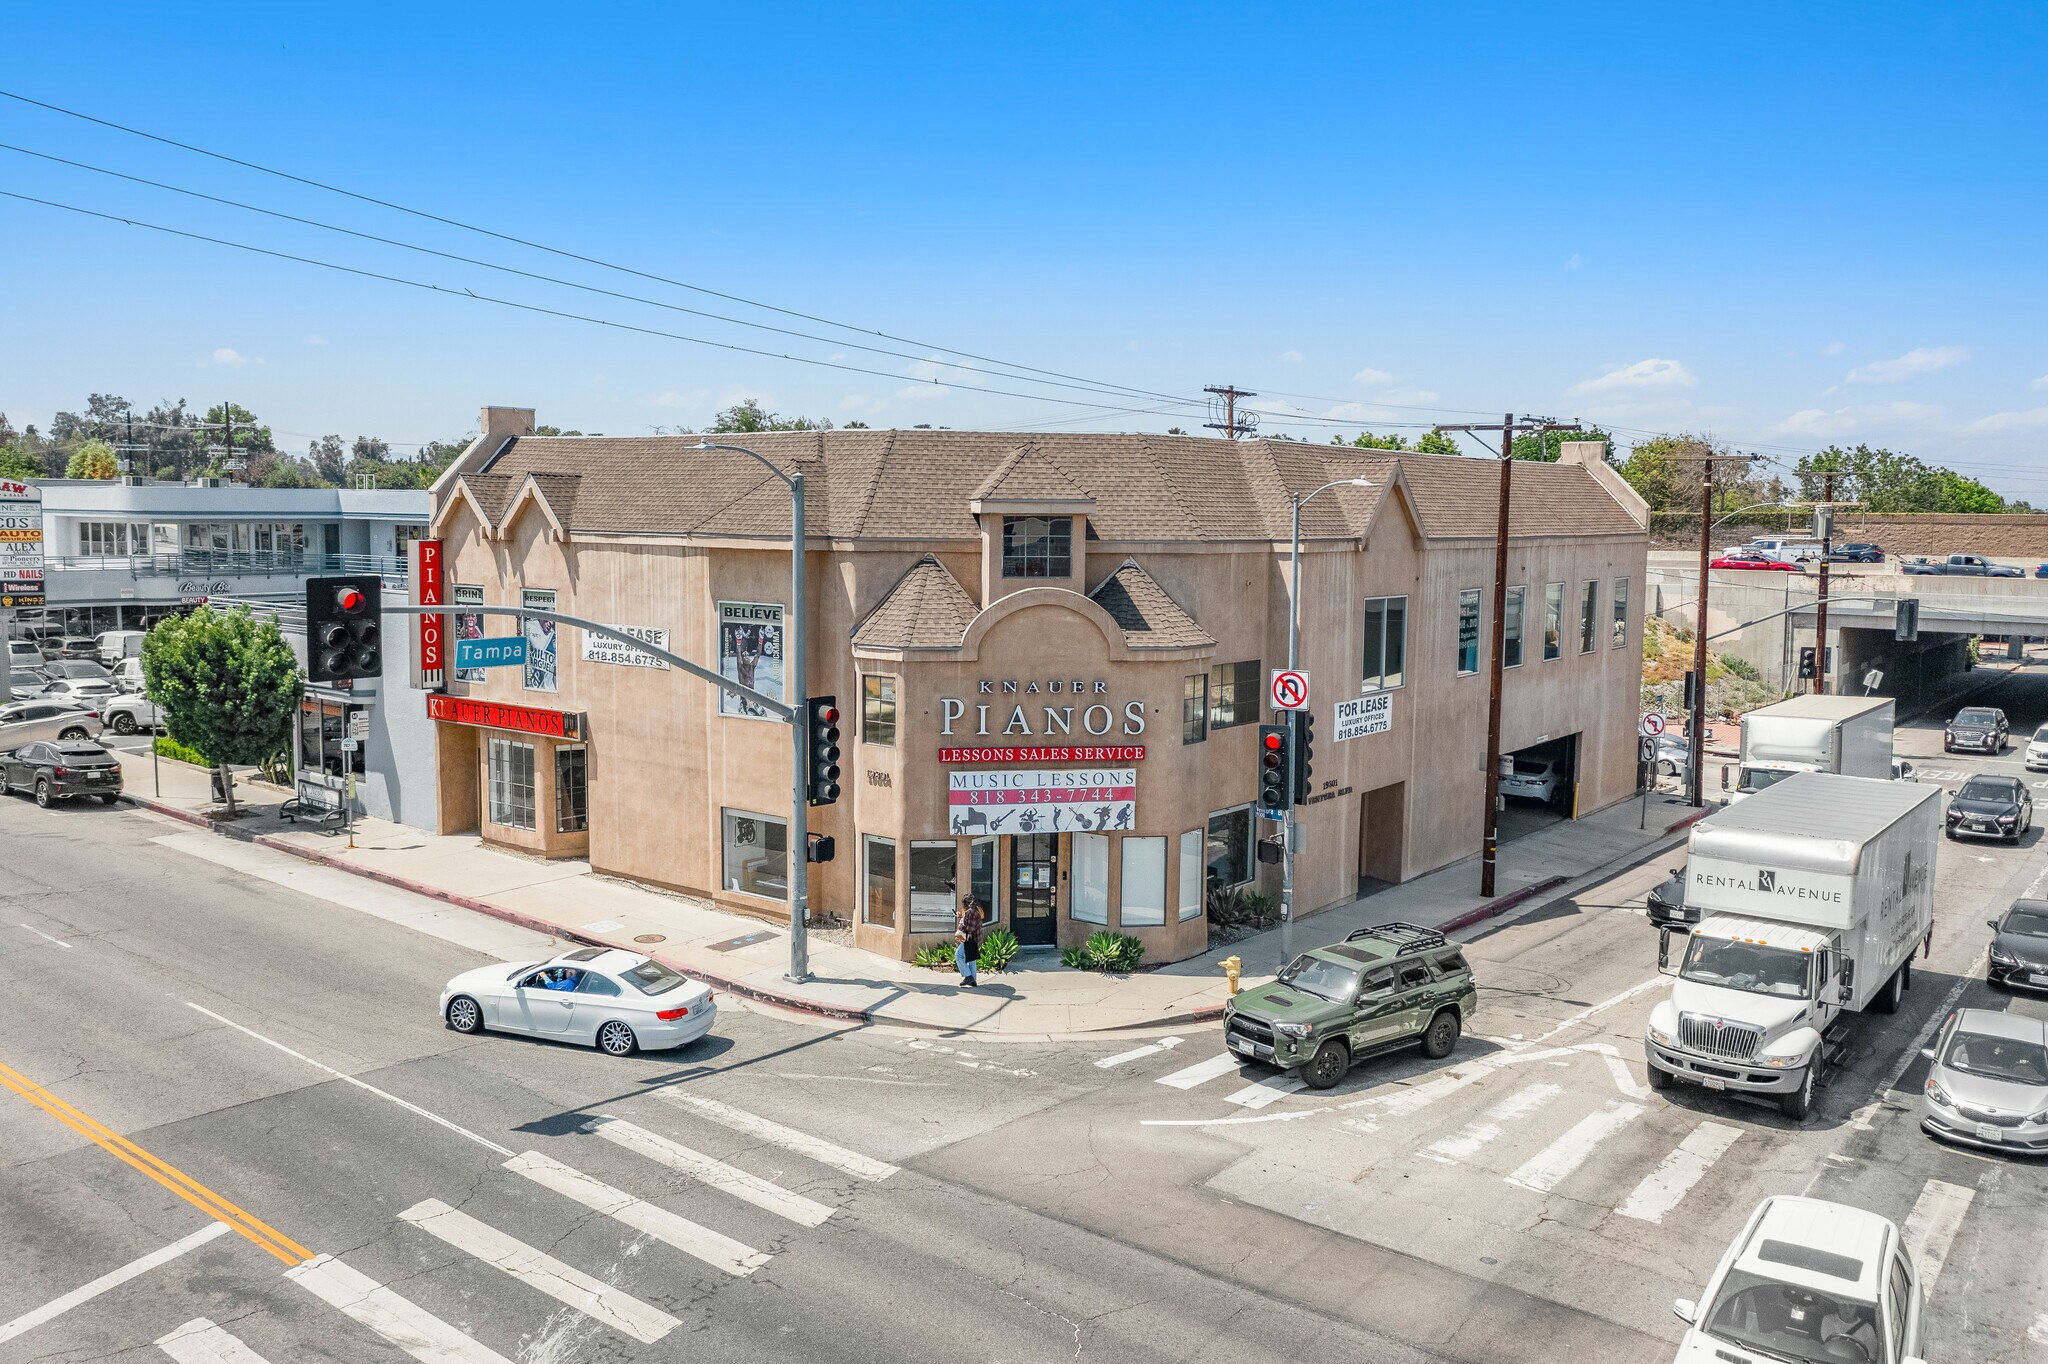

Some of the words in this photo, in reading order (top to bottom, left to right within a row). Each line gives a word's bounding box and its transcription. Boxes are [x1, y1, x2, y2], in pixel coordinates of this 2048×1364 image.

[6, 543, 36, 551] ALEX
[19, 569, 43, 579] NAILS
[424, 547, 437, 664] PIANOS
[724, 607, 781, 620] BELIEVE
[462, 644, 523, 661] Tampa
[592, 641, 623, 651] LUXURY
[588, 649, 663, 667] 818.854.6775
[979, 681, 1109, 694] KNAUER
[1338, 702, 1358, 719] FOR
[1360, 696, 1389, 715] LEASE
[498, 703, 560, 734] PIANOS
[940, 698, 1146, 736] PIANOS
[1341, 716, 1364, 728] LUXURY
[1363, 712, 1385, 723] OFFICES
[1338, 720, 1388, 740] 818.854.6775
[941, 748, 1014, 762] LESSONS
[1019, 748, 1069, 761] SALES
[1074, 747, 1145, 761] SERVICE
[952, 773, 1025, 789] MUSIC
[1037, 771, 1135, 787] LESSONS
[970, 790, 1006, 805] 818
[1018, 788, 1115, 803] 343-7744
[1696, 873, 1756, 892] RENTAL
[1776, 884, 1843, 903] AVENUE
